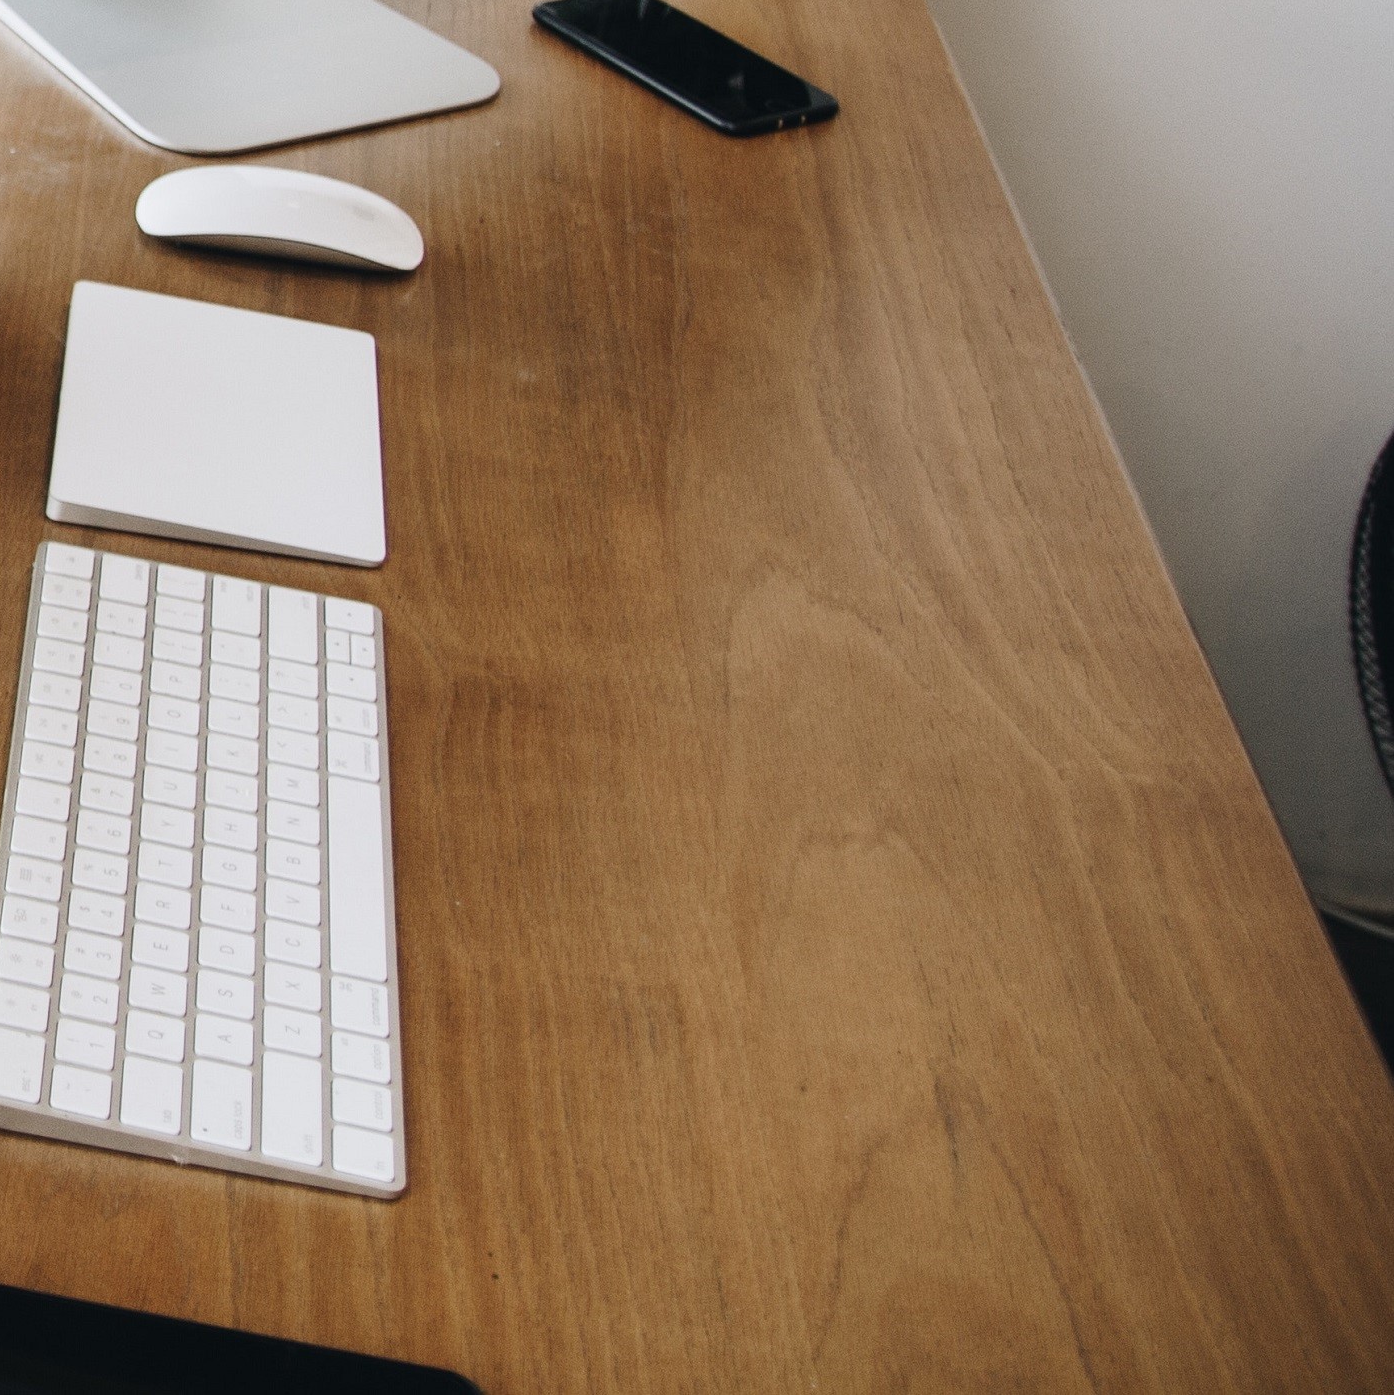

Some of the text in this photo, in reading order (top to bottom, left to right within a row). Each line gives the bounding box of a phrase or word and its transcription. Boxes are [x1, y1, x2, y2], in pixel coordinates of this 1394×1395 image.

[168, 675, 183, 685] P
[118, 682, 134, 692] 0
[115, 716, 131, 726] 9
[228, 715, 242, 723] L
[112, 753, 128, 762] 8
[226, 749, 240, 758] K
[162, 781, 179, 792] U
[286, 778, 301, 790] M
[109, 790, 125, 798] 7
[225, 786, 240, 795] J
[160, 820, 176, 828] Y
[286, 816, 301, 827] N
[106, 828, 123, 839] 6
[224, 823, 238, 833] H
[157, 859, 173, 867] T
[285, 855, 302, 866] B
[103, 867, 120, 878] 5
[221, 862, 238, 873] G
[154, 899, 171, 910] R
[285, 894, 301, 905] V
[220, 903, 236, 913] F
[100, 909, 116, 919] 4
[152, 941, 170, 952] E
[284, 937, 302, 948] C
[218, 944, 236, 956] D
[95, 951, 112, 962] 3
[151, 982, 167, 998] W
[284, 980, 301, 992] X
[217, 988, 234, 999] S
[92, 995, 109, 1005] 2
[370, 987, 381, 1027] command
[146, 1029, 165, 1041] Q
[284, 1024, 302, 1036] Z
[216, 1034, 232, 1045] A
[372, 1043, 383, 1072] option
[373, 1090, 384, 1121] control
